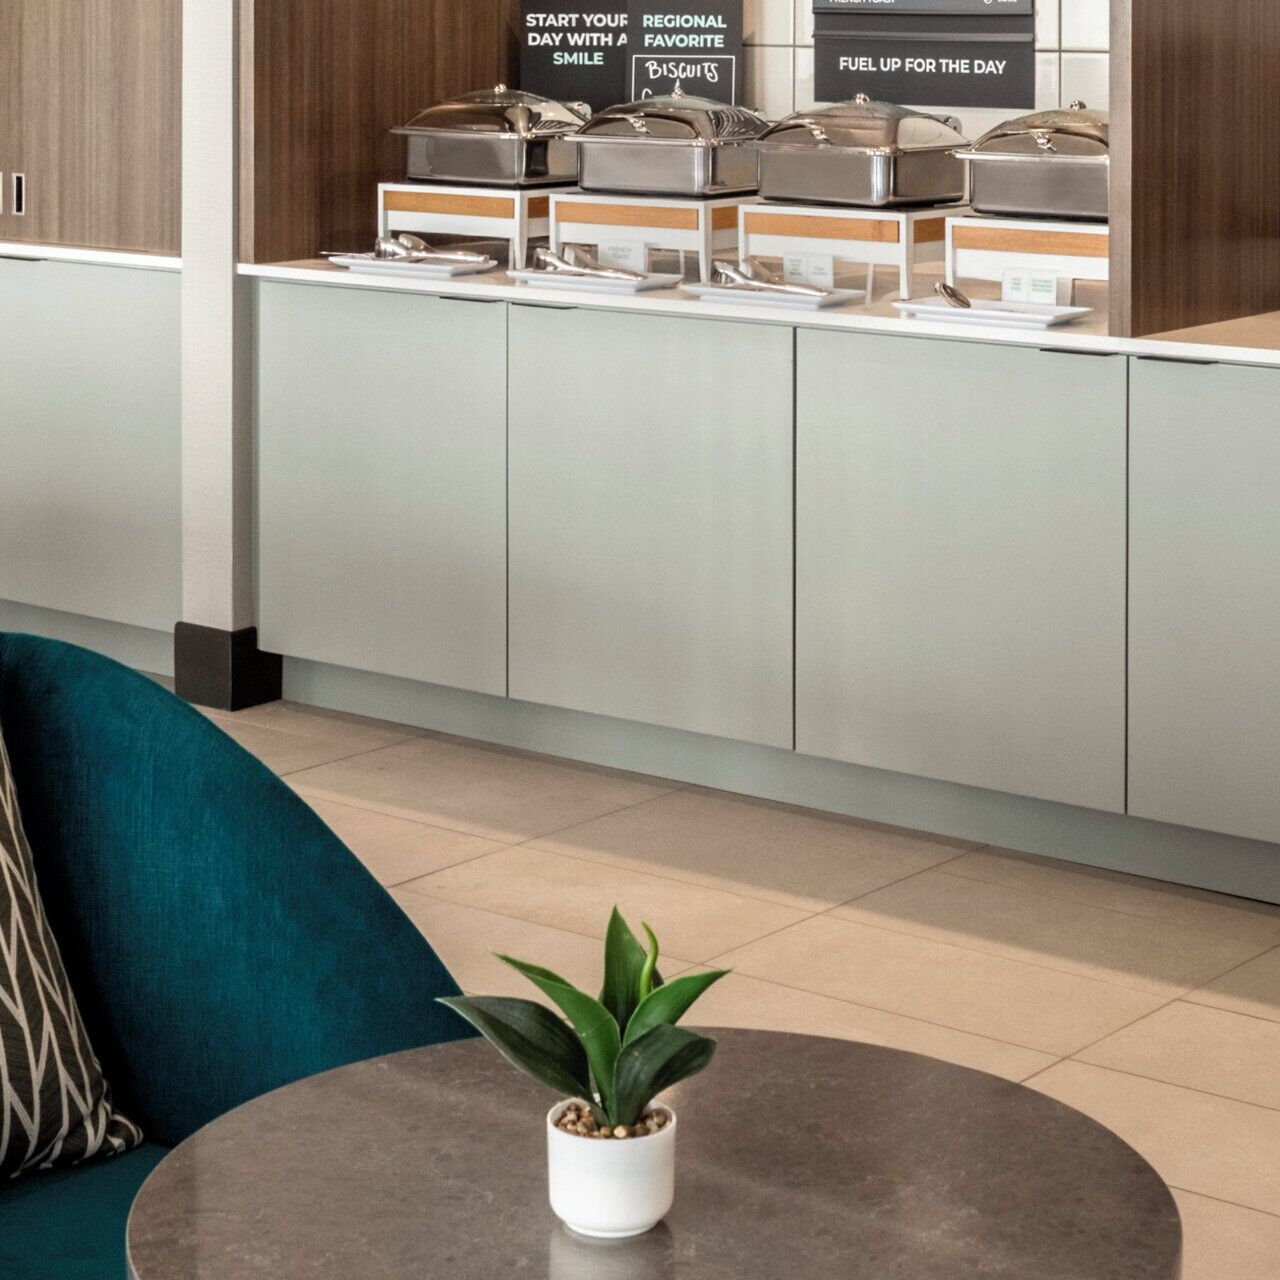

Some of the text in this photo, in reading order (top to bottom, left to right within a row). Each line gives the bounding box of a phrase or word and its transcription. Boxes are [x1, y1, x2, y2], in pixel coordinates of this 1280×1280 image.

[527, 14, 628, 27] START YOUR
[643, 15, 727, 28] REGIONAL
[528, 33, 627, 46] DAY WITH A
[645, 34, 724, 47] FAVORITE
[554, 52, 603, 64] SMILE
[645, 60, 718, 82] BISCUITS
[840, 57, 1006, 74] FUEL UP FOR THE DAY
